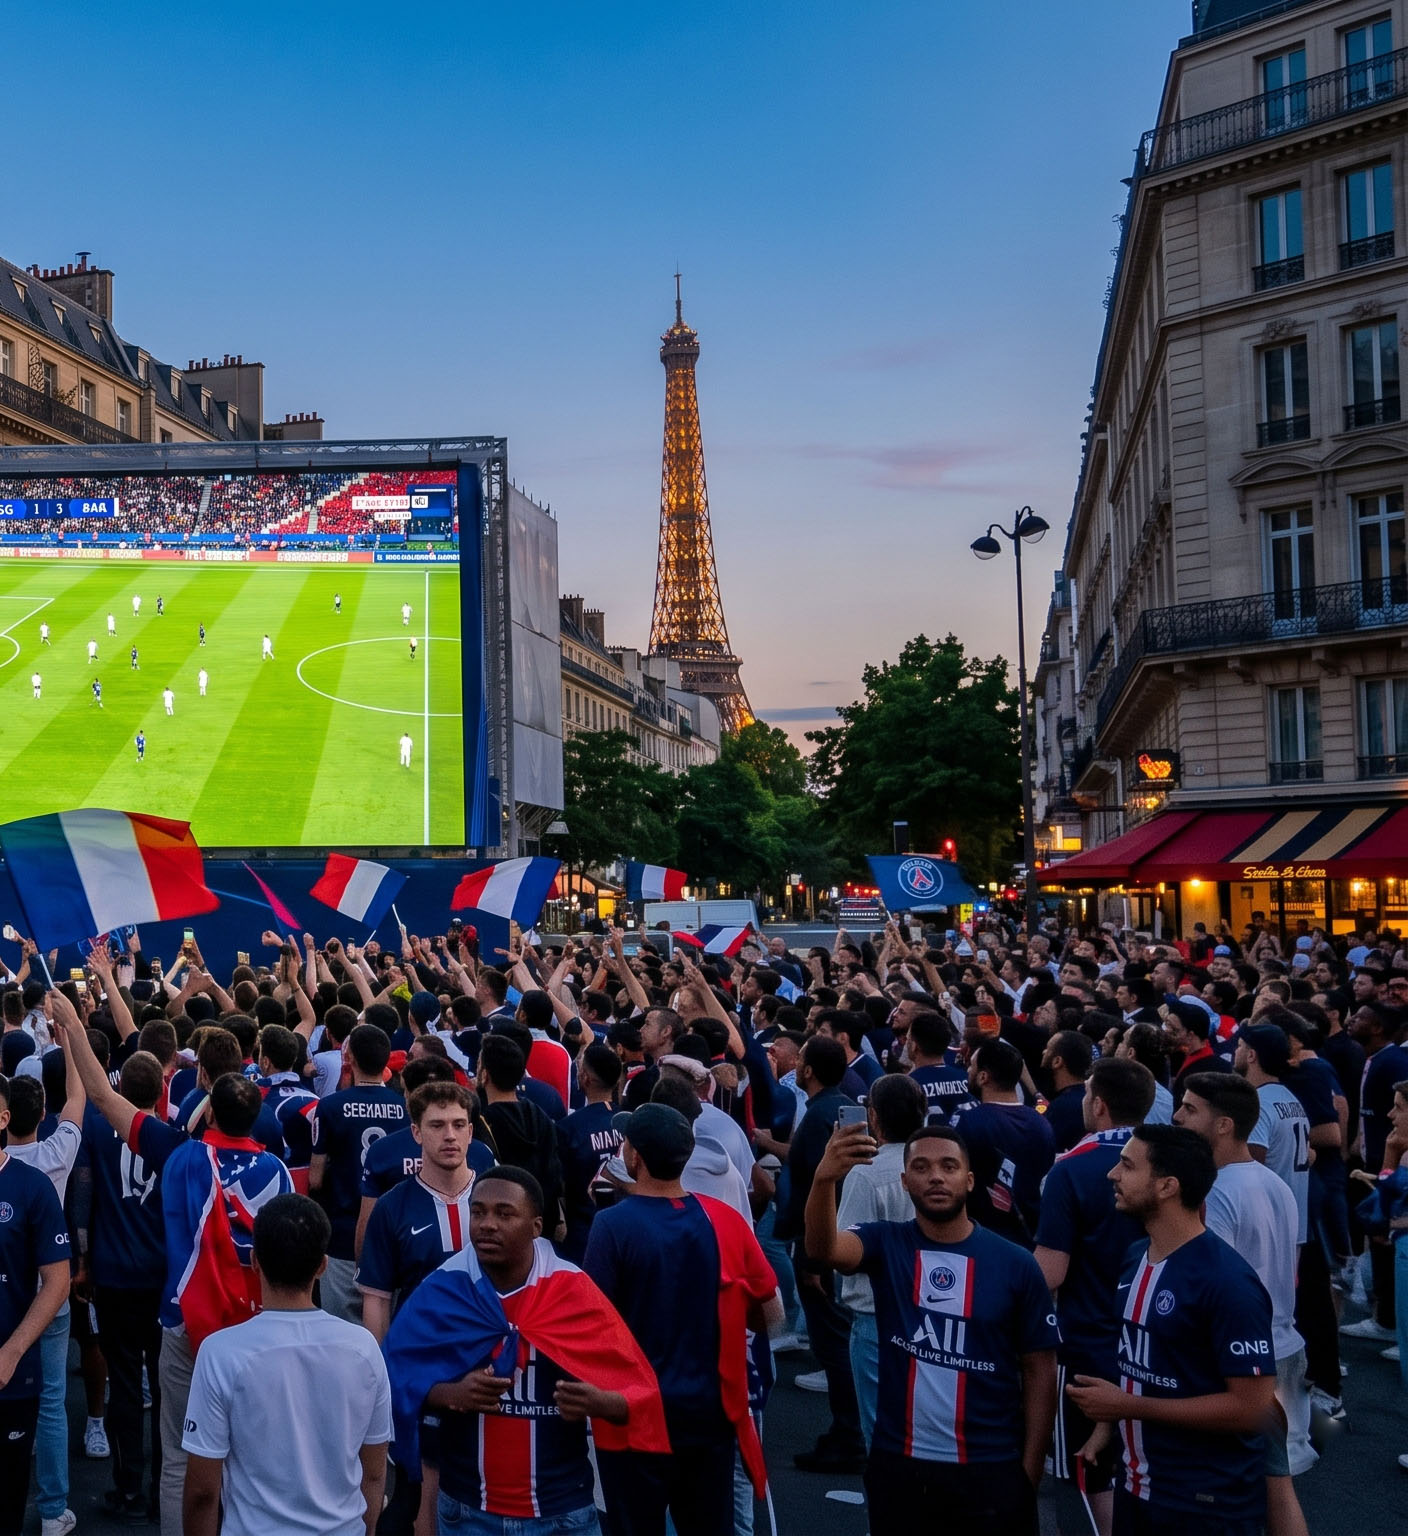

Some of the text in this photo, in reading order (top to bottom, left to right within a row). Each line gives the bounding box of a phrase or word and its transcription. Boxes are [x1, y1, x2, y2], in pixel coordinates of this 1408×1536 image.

[34, 503, 40, 515] 1
[56, 503, 63, 515] 3
[1230, 1340, 1270, 1356] QNB
[918, 1348, 942, 1363] LIVE
[943, 1355, 996, 1372] LIMITLESS
